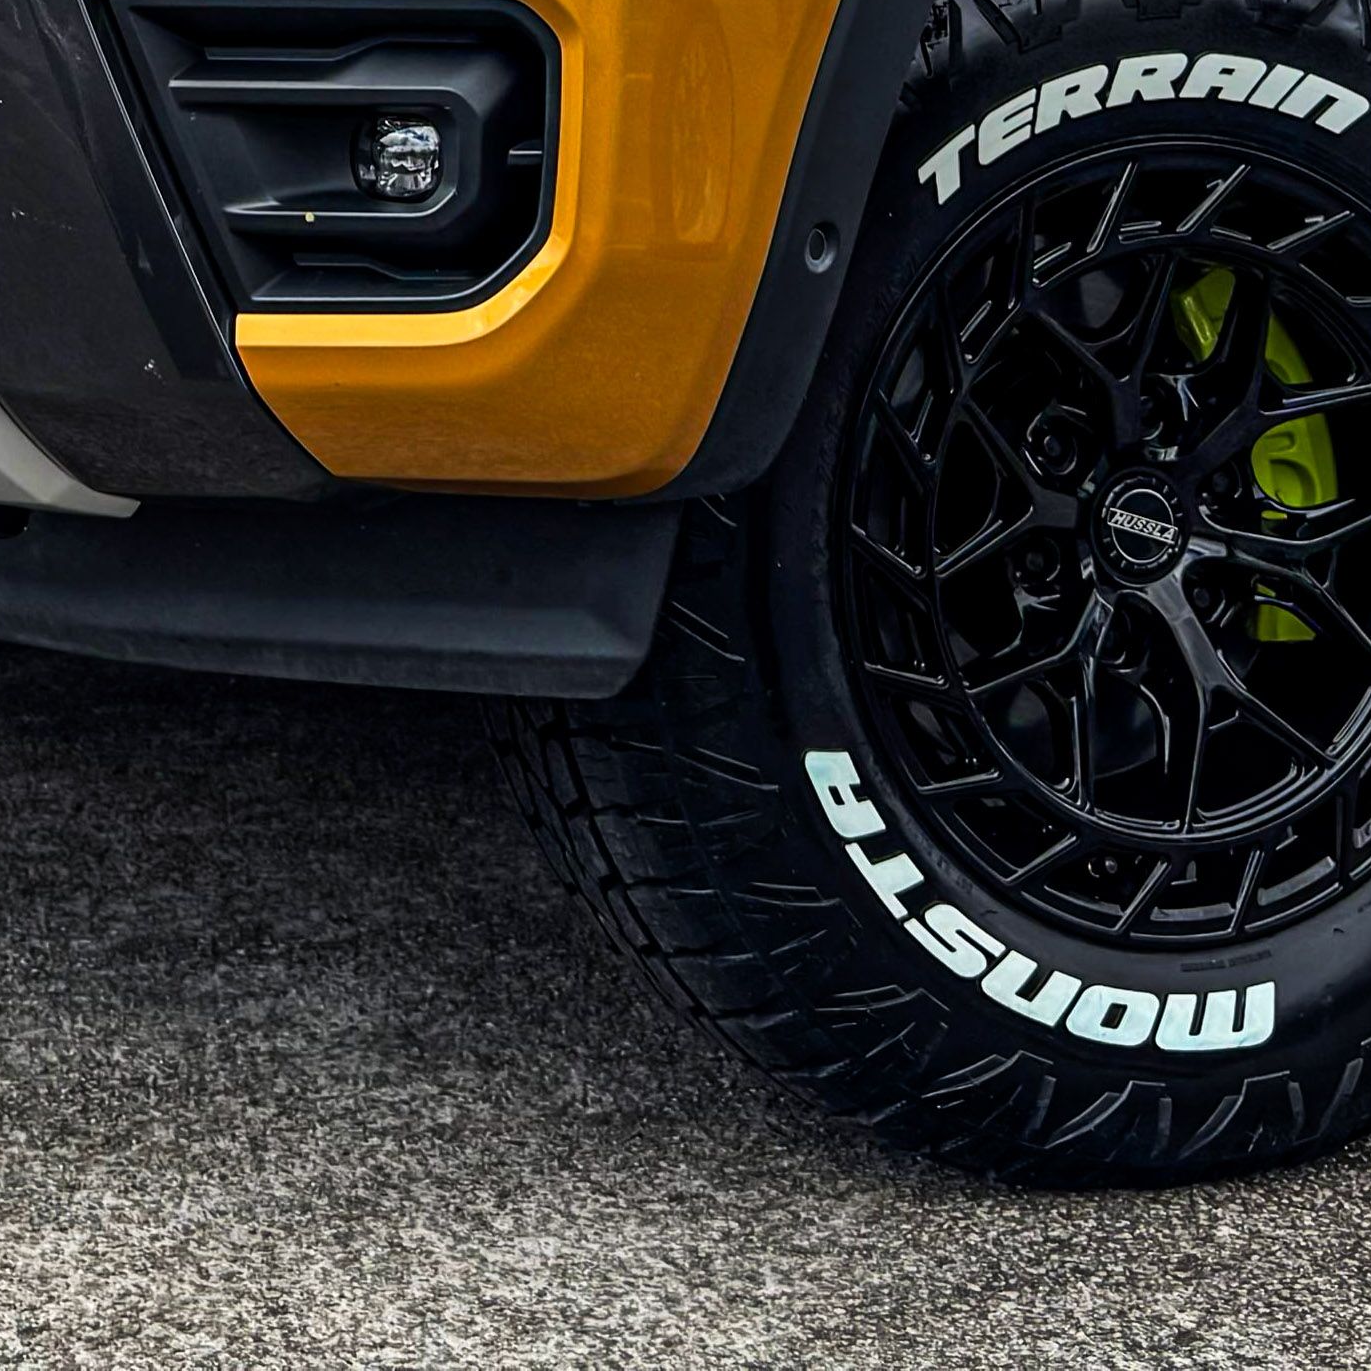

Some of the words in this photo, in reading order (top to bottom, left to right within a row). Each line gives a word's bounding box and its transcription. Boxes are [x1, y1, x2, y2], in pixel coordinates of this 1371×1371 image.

[917, 52, 1371, 205] TERRAIN
[1110, 511, 1176, 541] HUSSLA
[803, 749, 1276, 1052] MONSTA
